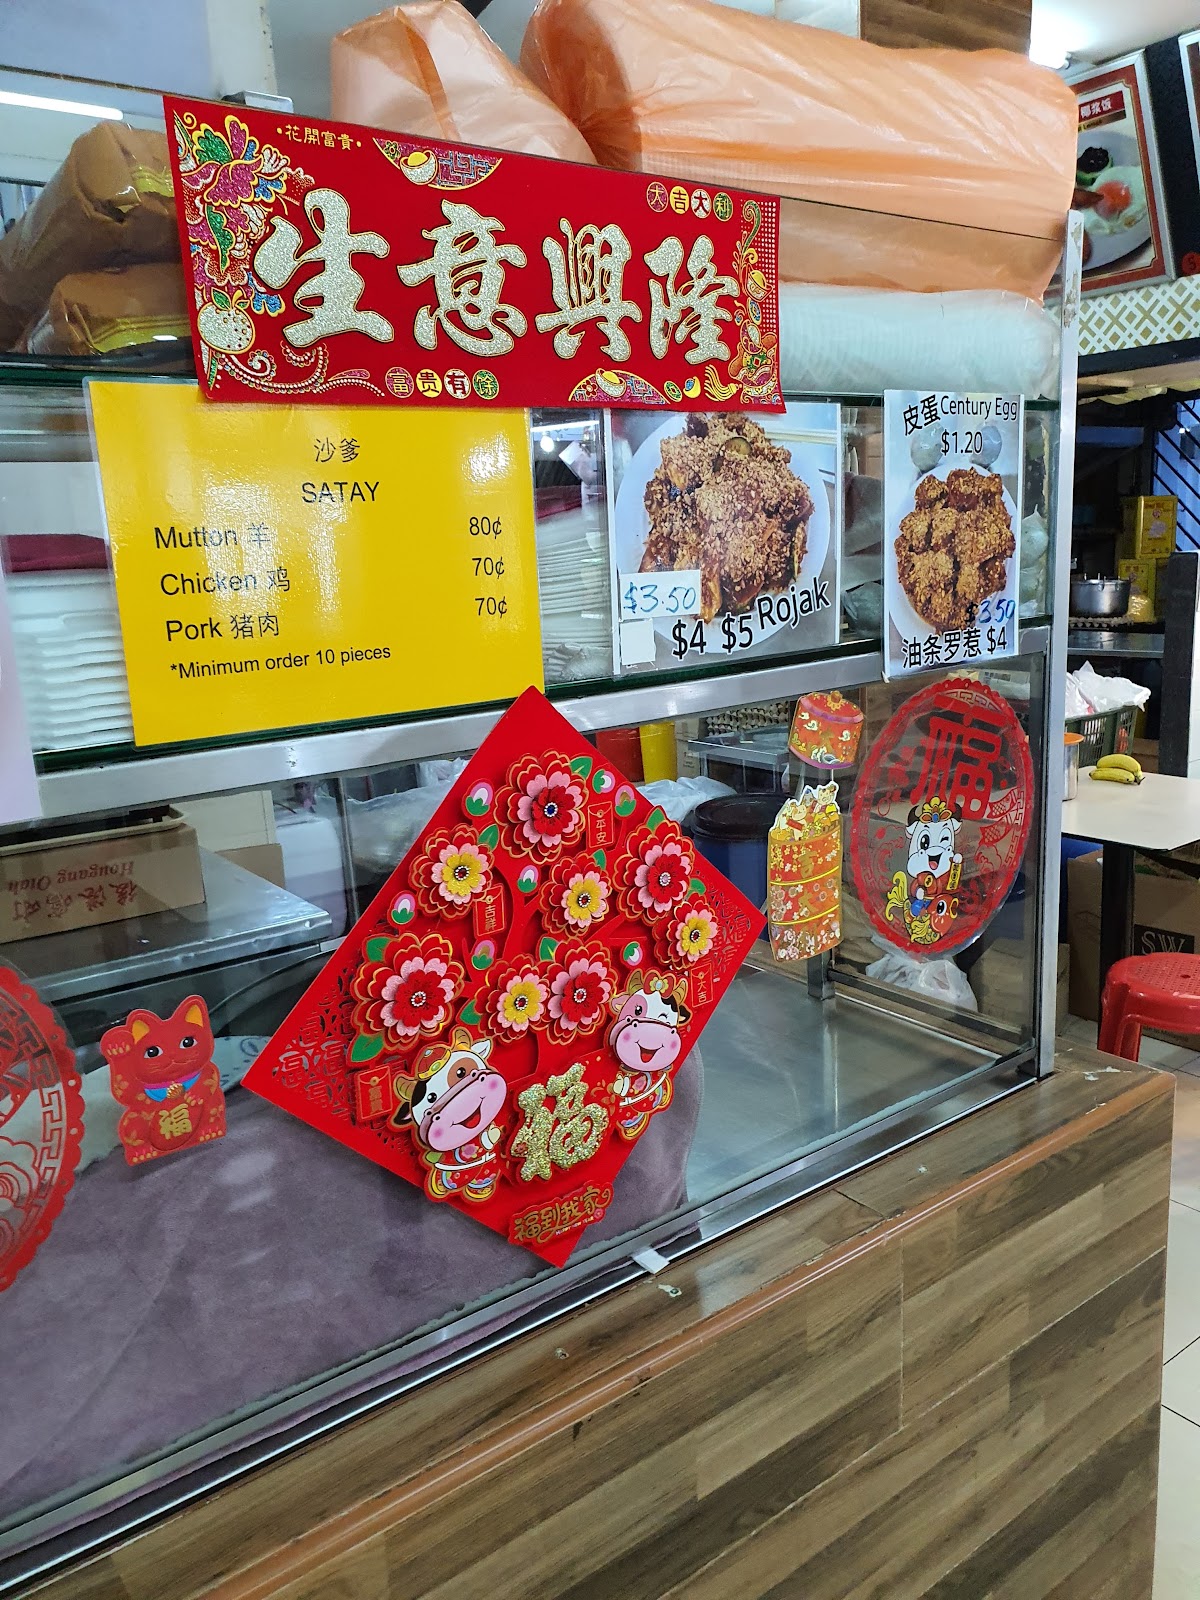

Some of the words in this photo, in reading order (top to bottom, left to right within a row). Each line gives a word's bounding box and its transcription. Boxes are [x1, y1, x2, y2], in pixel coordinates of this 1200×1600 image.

[649, 183, 733, 221] 大吉大利
[254, 187, 741, 366] 生意興隆
[903, 394, 941, 436] 皮蛋
[940, 395, 992, 420] Century
[995, 397, 1018, 421] Egg
[313, 437, 361, 463] 沙爹
[941, 429, 983, 456] $1.20
[301, 481, 380, 504] SATAY
[154, 526, 238, 549] Mutton
[246, 522, 271, 549] 羊
[469, 516, 502, 540] 80¢
[160, 572, 258, 596] Chicken
[266, 566, 291, 592] 鸡
[472, 556, 505, 580] 70¢
[623, 581, 698, 614] $3.50
[166, 617, 223, 642] Pork
[230, 611, 280, 640] 猪肉
[475, 596, 508, 619] 70¢
[672, 618, 707, 660] $4
[721, 613, 753, 652] $5
[757, 576, 831, 630] Rojak
[265, 653, 310, 671] order
[315, 648, 336, 666] 10
[340, 646, 391, 667] pieces
[902, 627, 981, 669] 油条罗惹
[986, 625, 1007, 655] $4
[697, 980, 708, 1003] 大吉
[159, 1103, 192, 1140] 福
[511, 1062, 609, 1182] 福
